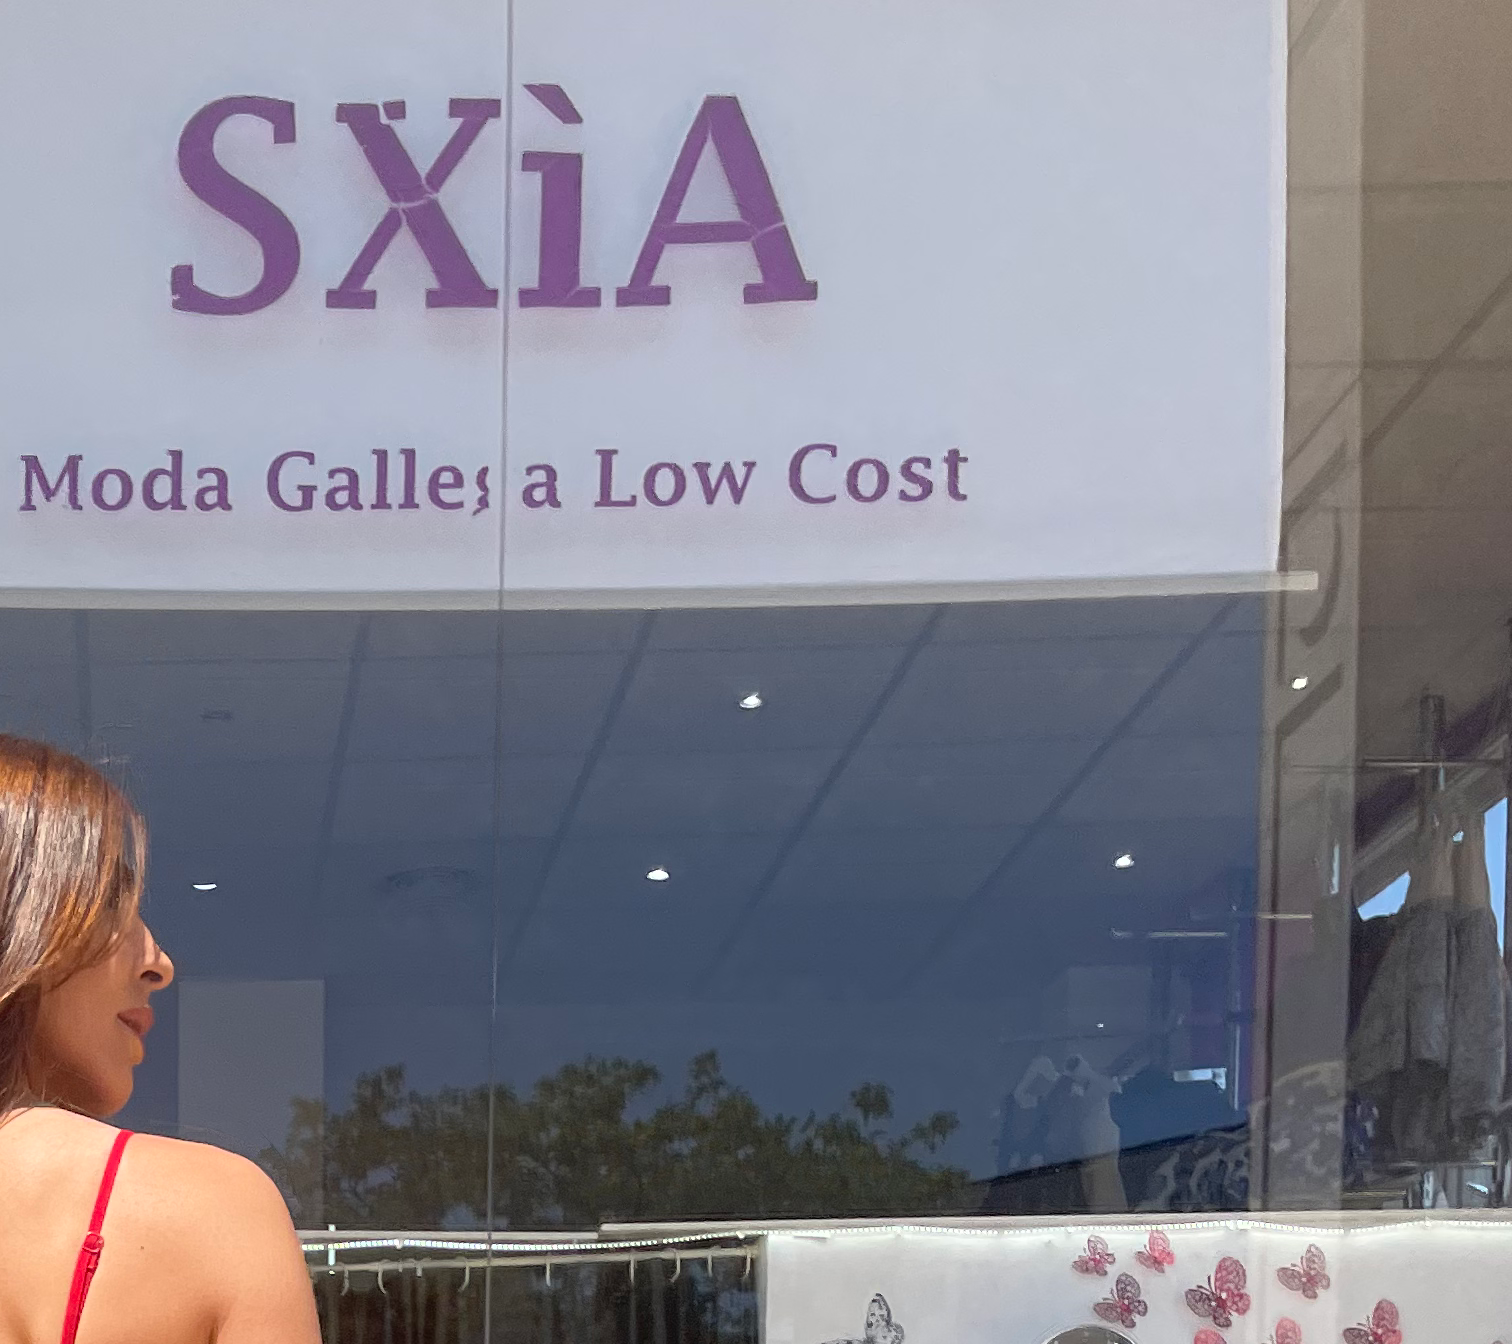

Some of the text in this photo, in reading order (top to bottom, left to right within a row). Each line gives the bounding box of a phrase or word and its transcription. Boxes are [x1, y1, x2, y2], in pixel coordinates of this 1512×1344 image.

[19, 449, 233, 513] Moda
[593, 448, 757, 508] Low
[787, 442, 970, 505] Cost
